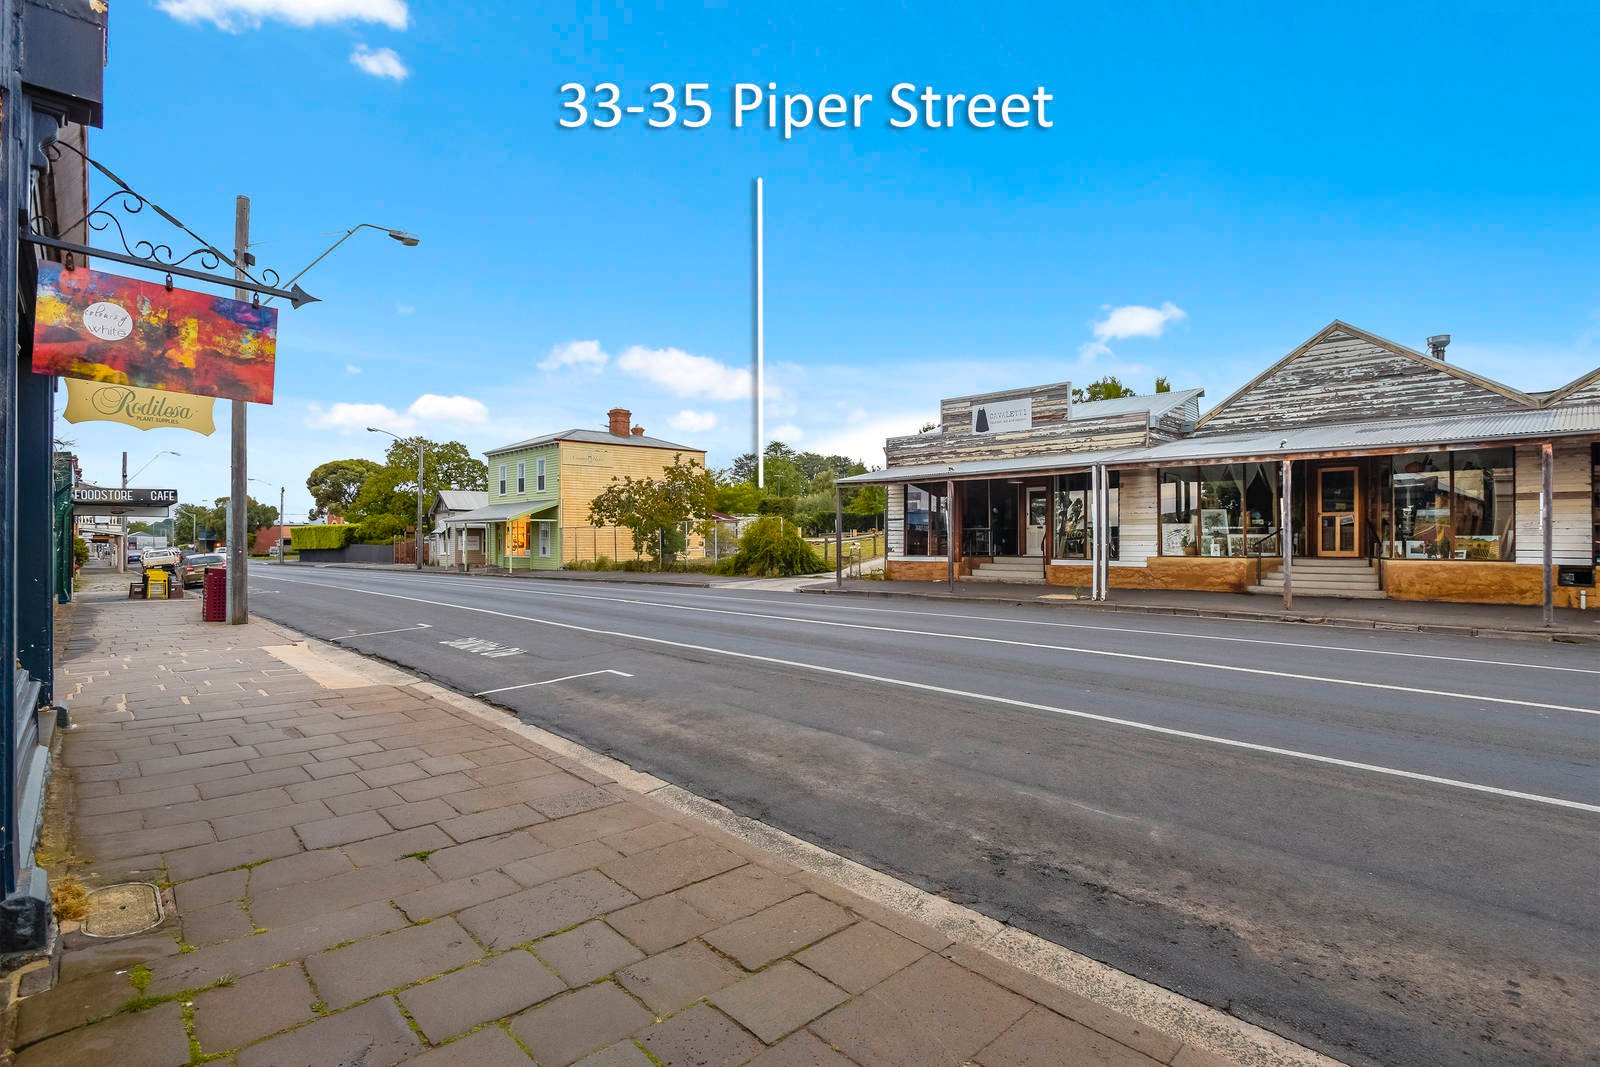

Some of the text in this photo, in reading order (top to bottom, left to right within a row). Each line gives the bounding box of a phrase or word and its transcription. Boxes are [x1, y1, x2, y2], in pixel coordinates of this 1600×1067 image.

[88, 324, 127, 338] white
[136, 415, 180, 425] PLANT SUPPLIES
[74, 489, 175, 501] FOODSTORE CAFE
